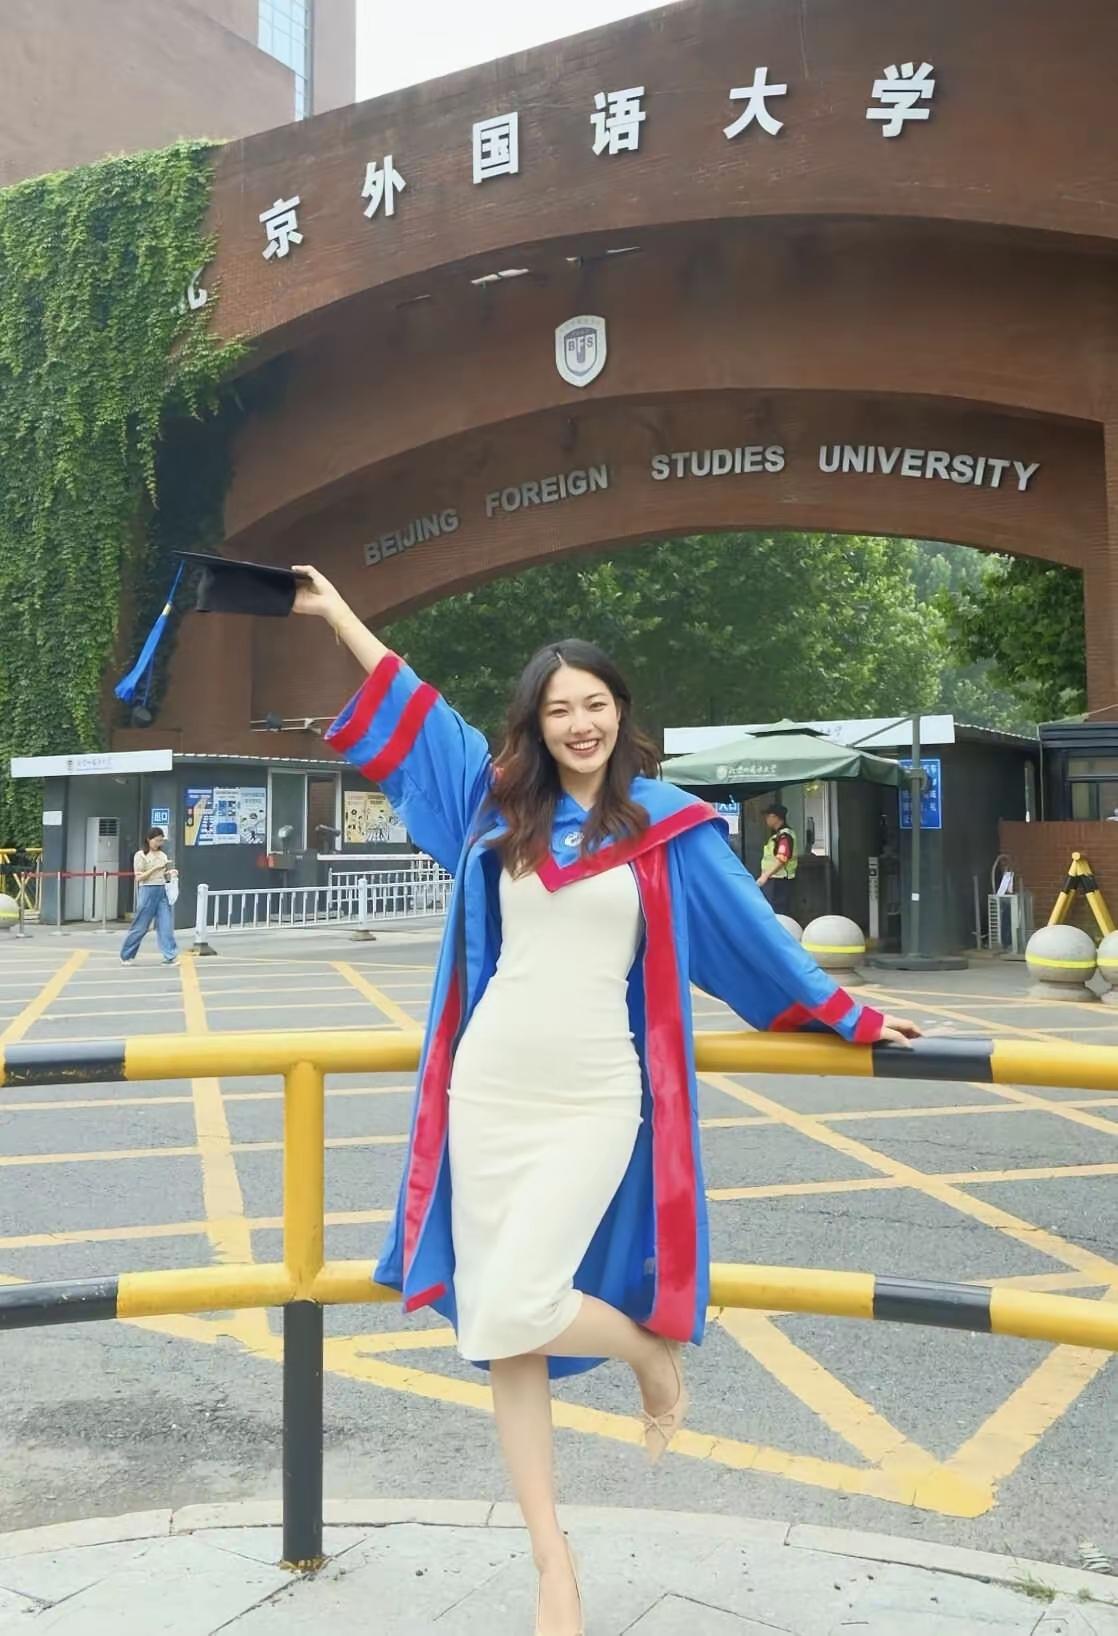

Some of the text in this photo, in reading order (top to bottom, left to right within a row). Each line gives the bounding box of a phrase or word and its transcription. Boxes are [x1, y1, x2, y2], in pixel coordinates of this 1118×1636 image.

[363, 445, 1040, 566] BEIJING FOREIGN STUDIES UNIVERSITY
